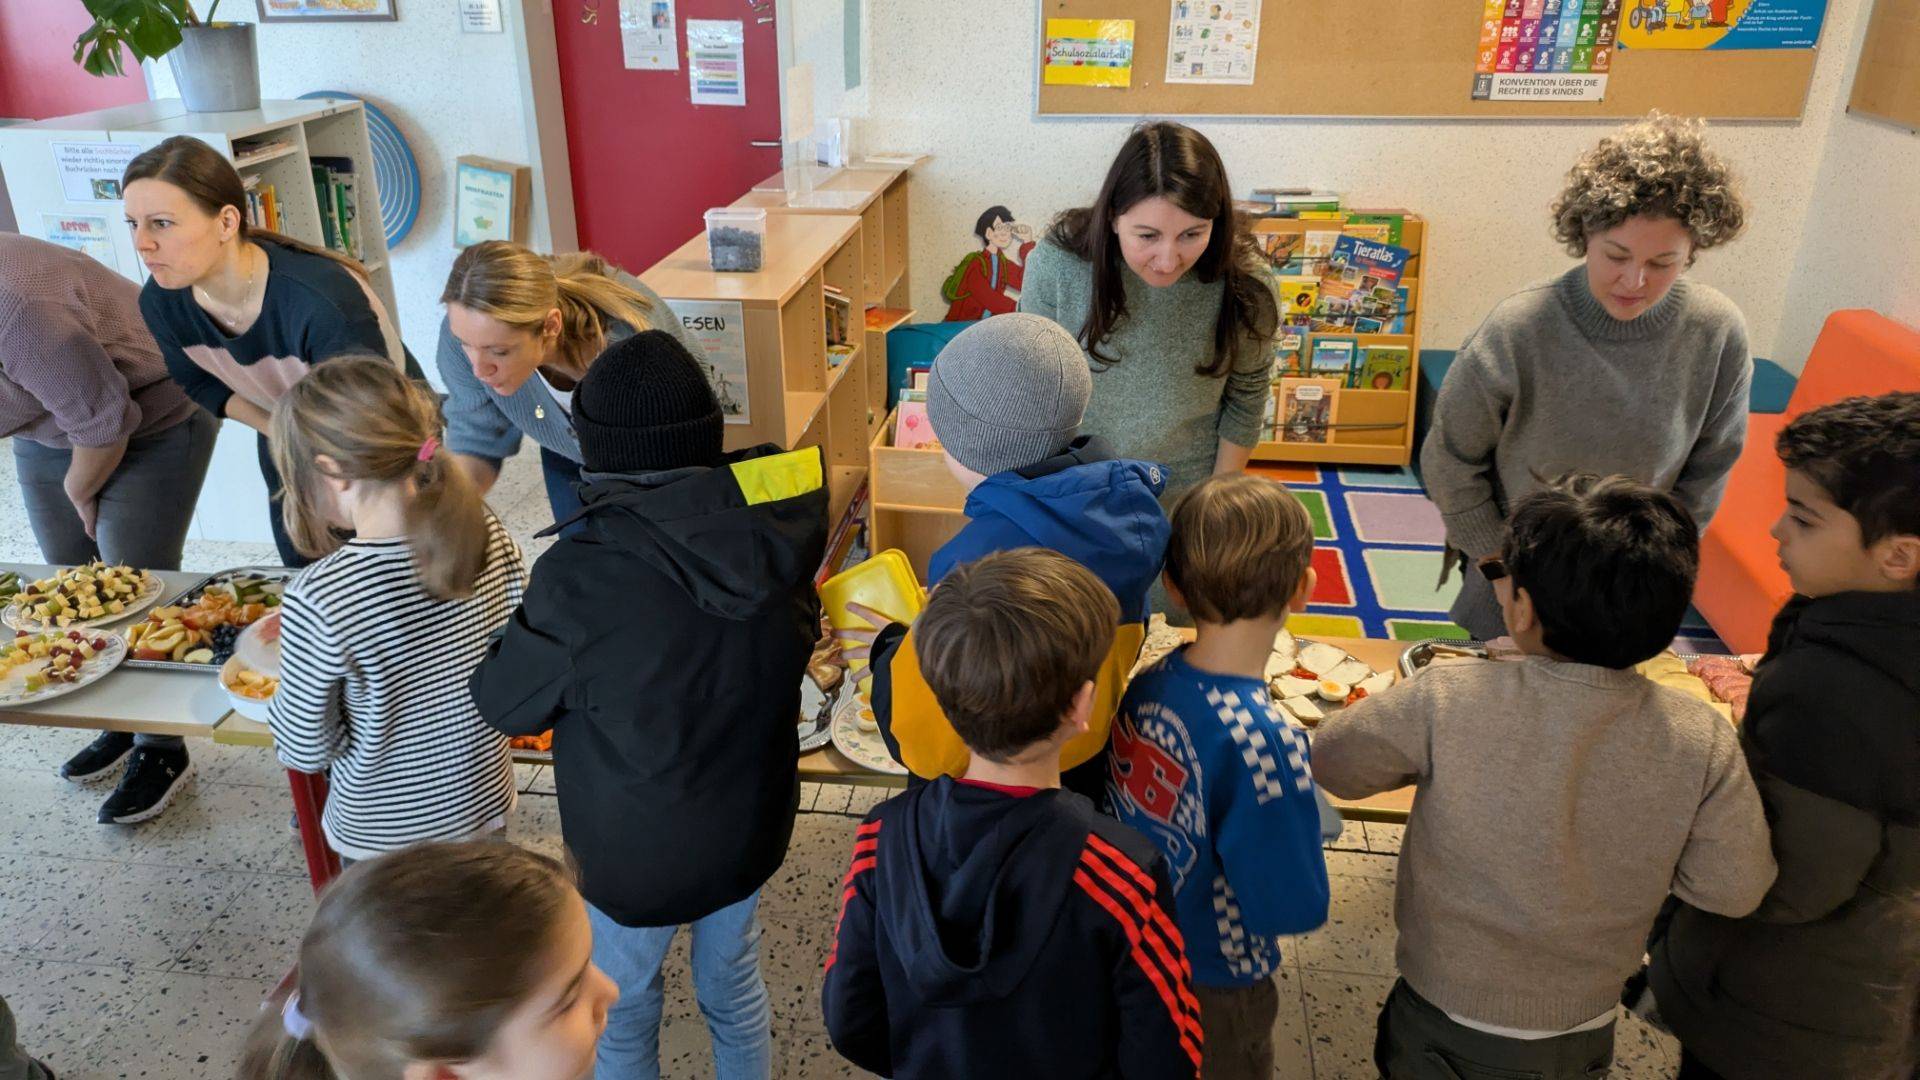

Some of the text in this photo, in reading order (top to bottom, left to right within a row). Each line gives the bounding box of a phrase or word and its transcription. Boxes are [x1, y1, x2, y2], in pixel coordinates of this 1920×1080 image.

[1052, 46, 1127, 59] Schulsozialarbeit
[1499, 76, 1599, 87] KONVENTION ÜBER DIE
[1497, 87, 1531, 95] RECHTE
[1533, 87, 1551, 96] DES
[1552, 88, 1584, 96] KINDES
[1353, 240, 1395, 263] Tieratlas
[682, 316, 726, 331] ESEN
